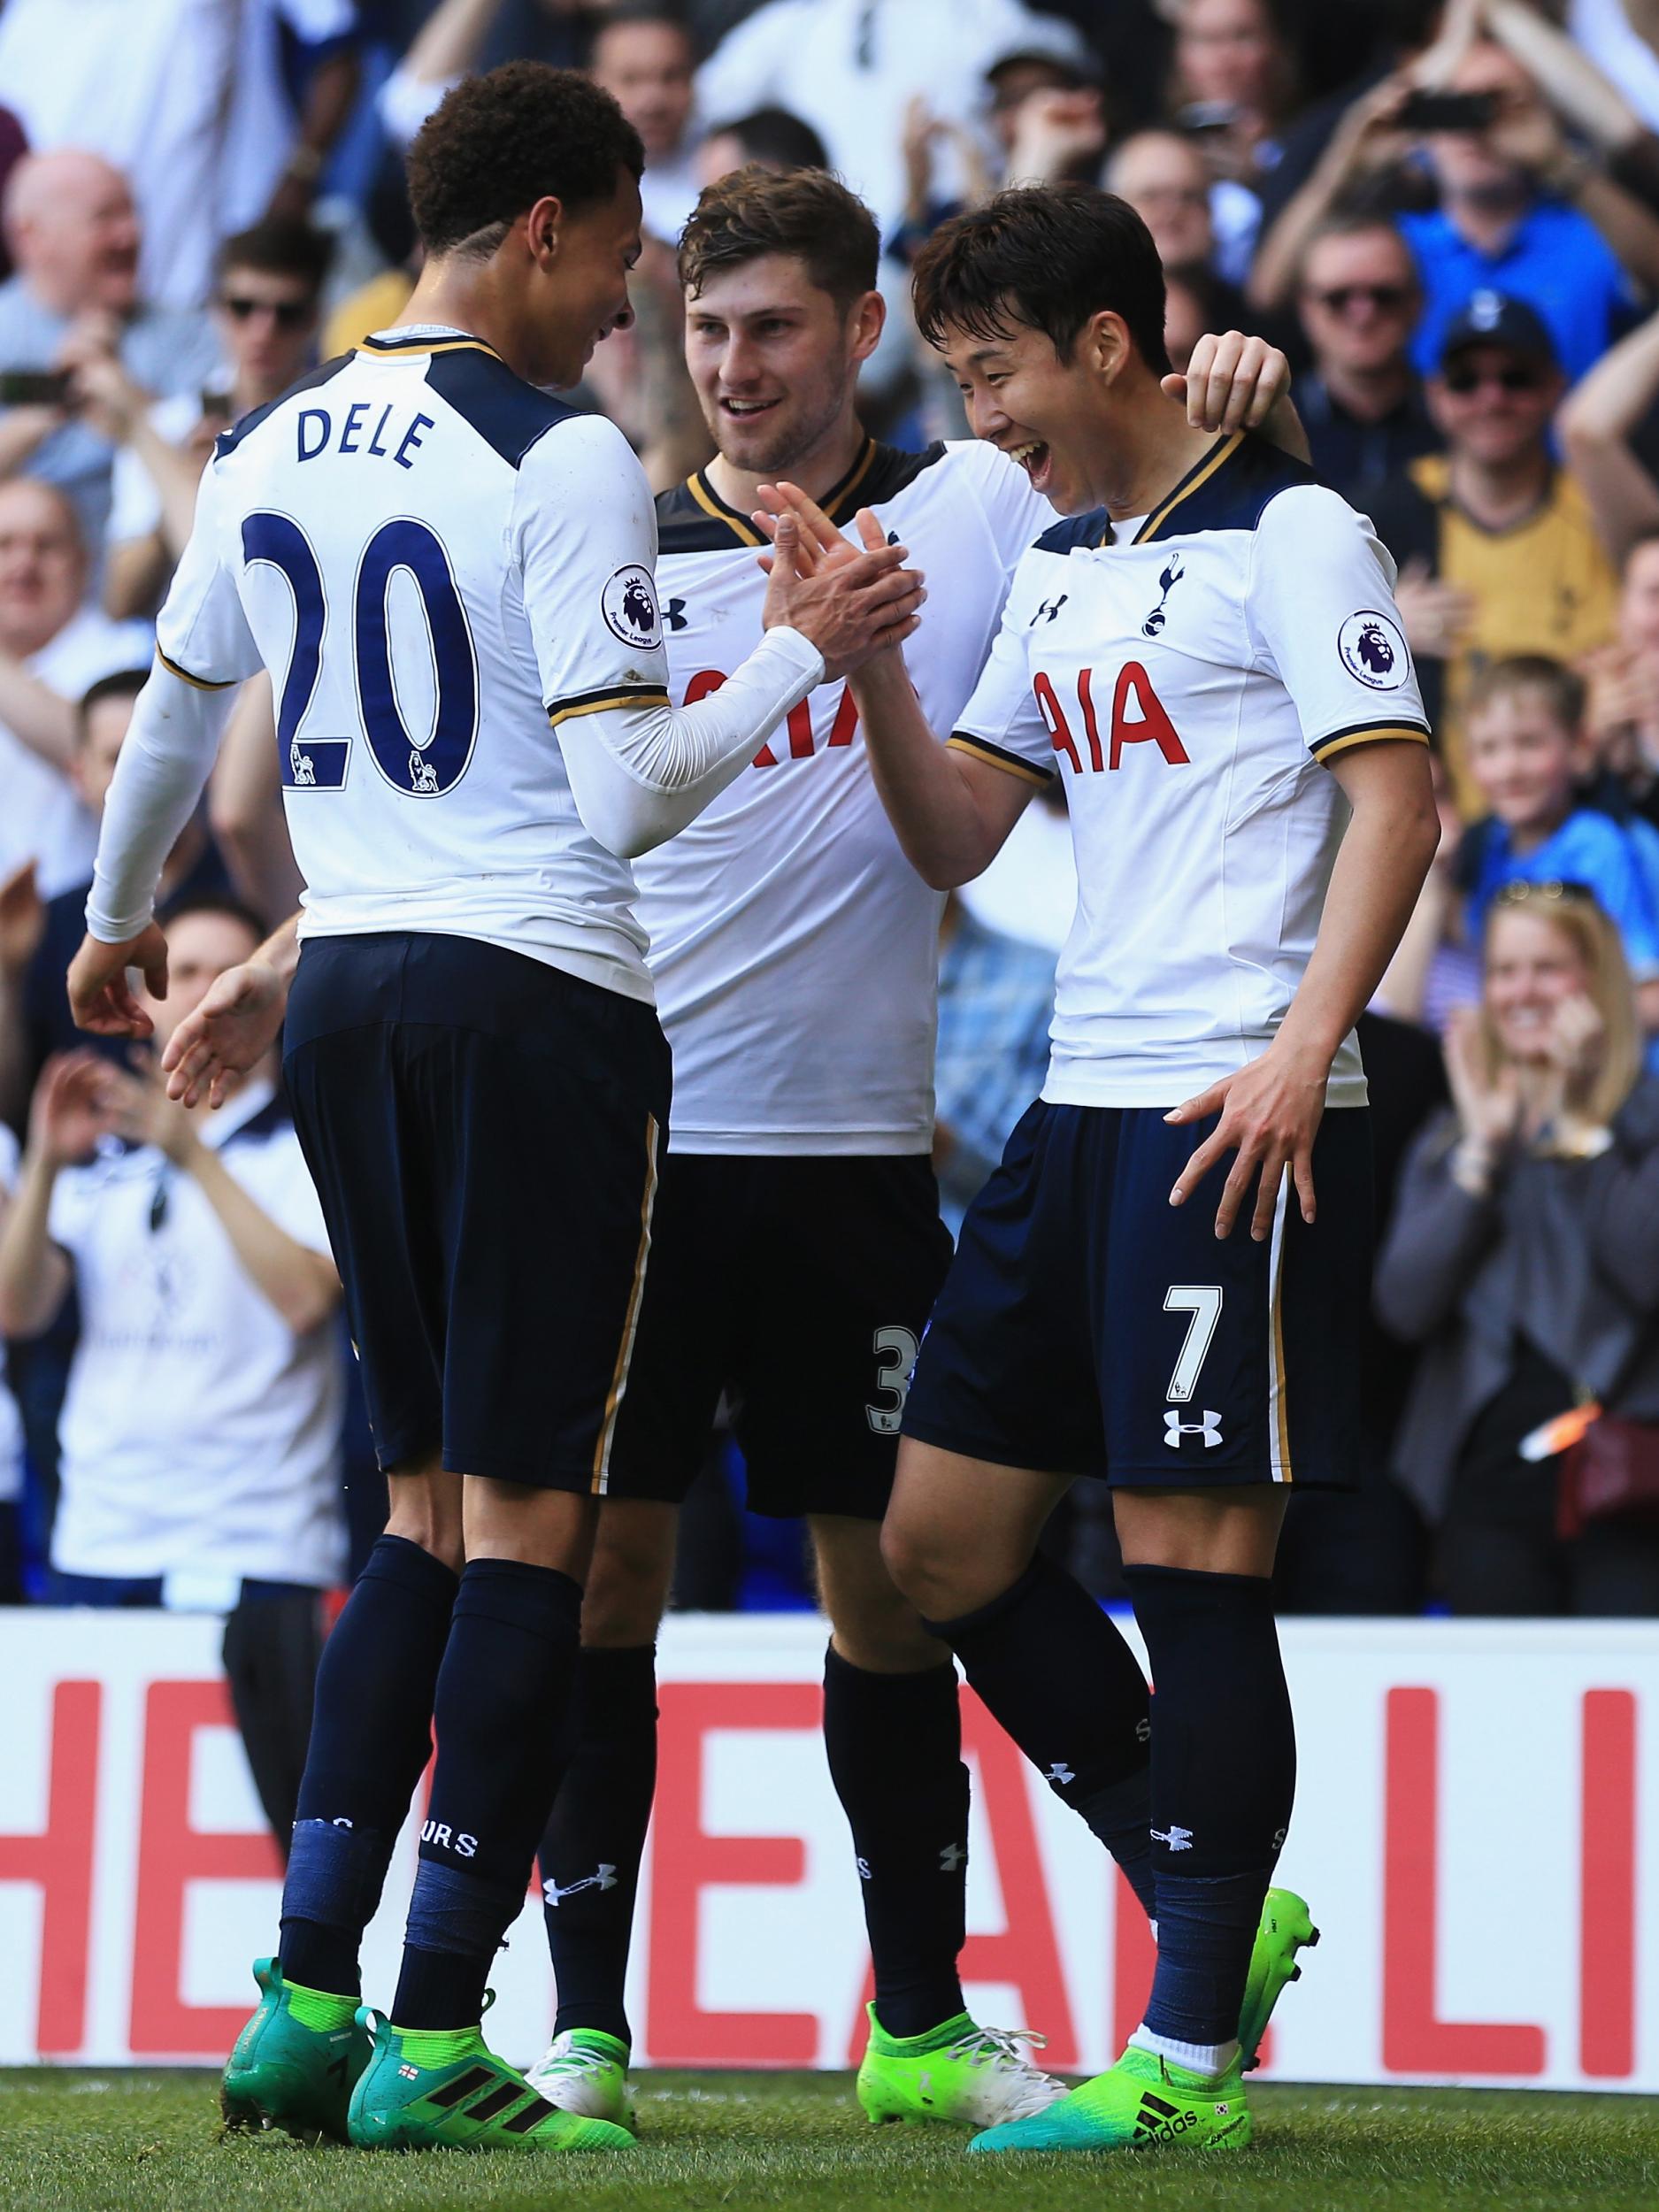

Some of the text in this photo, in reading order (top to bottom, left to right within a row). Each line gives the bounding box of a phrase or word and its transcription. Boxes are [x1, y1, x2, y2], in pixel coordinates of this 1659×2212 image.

[297, 403, 435, 470] DELE
[240, 507, 480, 799] 20
[610, 611, 629, 636] Premier
[1344, 646, 1384, 685] Premier League
[1033, 660, 1191, 775] AIA
[864, 1325, 921, 1435] 3
[1162, 1285, 1224, 1402] 7
